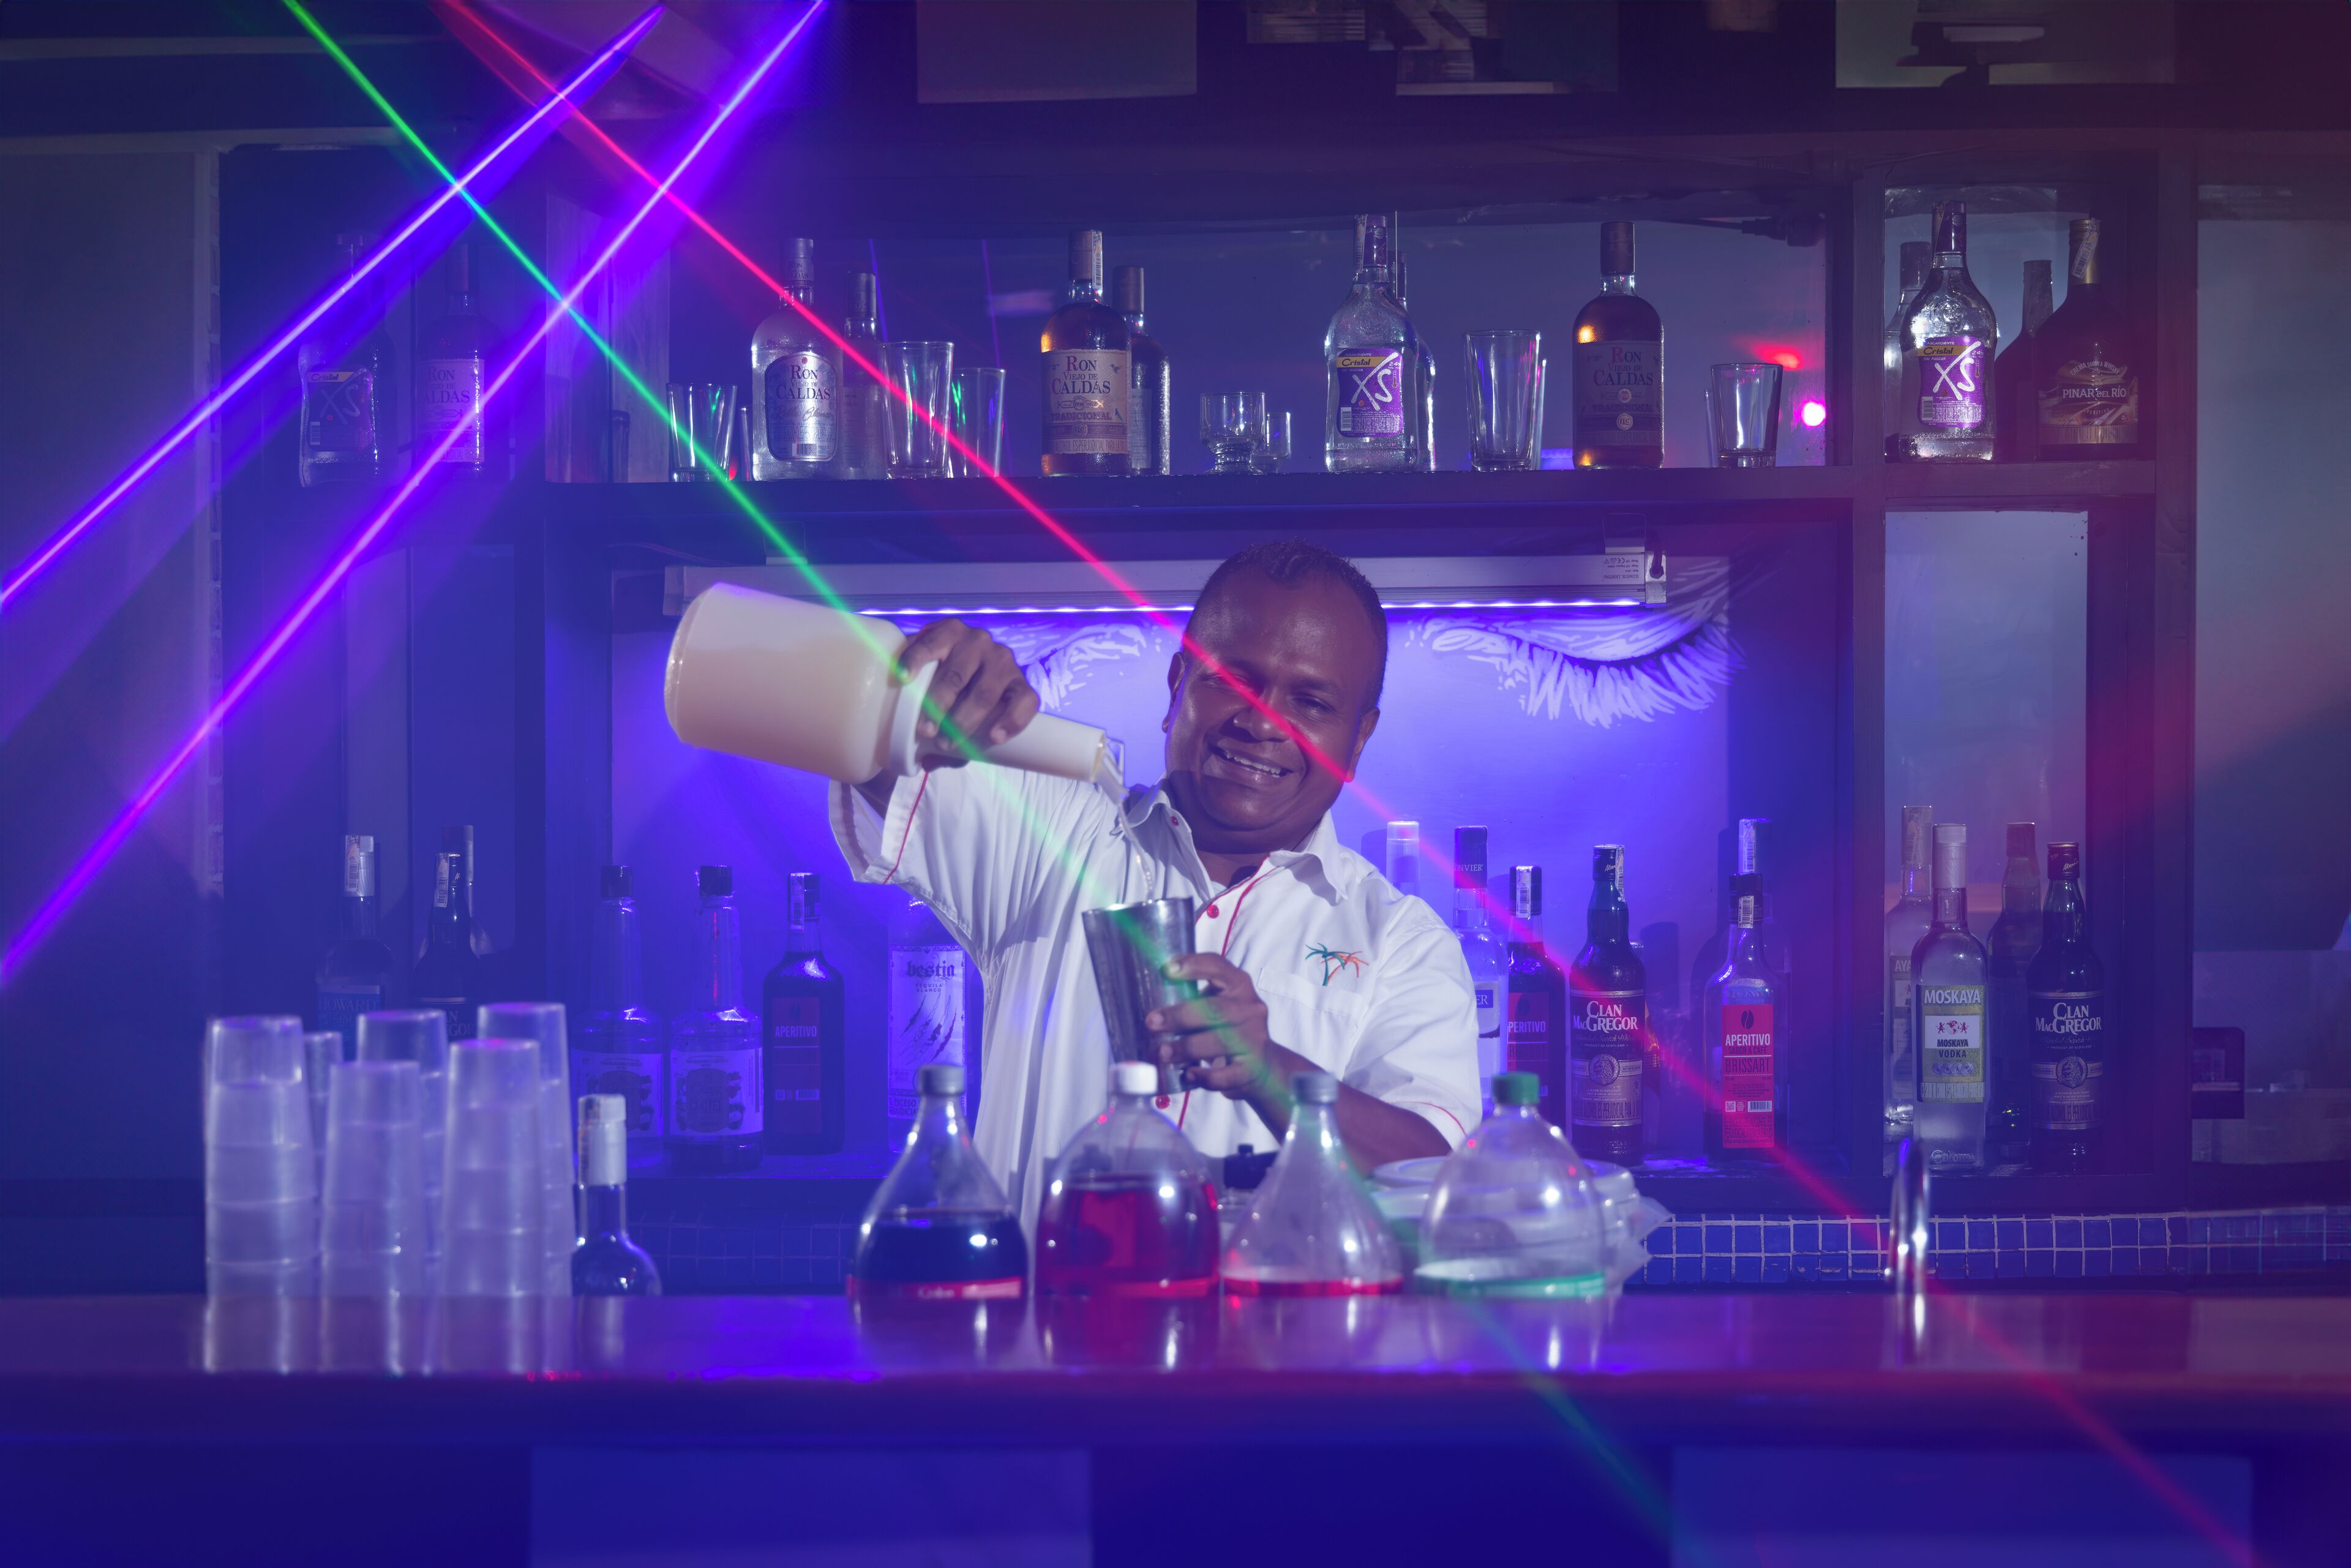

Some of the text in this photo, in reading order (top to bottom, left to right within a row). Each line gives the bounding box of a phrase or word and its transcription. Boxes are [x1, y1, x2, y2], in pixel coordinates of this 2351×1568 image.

[1611, 347, 1641, 363] RON
[1923, 347, 1954, 355] Cristal
[1065, 355, 1097, 371] RON
[1341, 358, 1371, 367] Cristal
[1608, 363, 1631, 372] VIEJO
[2070, 362, 2087, 376] CREMA
[789, 365, 819, 380] RON
[1063, 372, 1086, 380] VIEJO
[1593, 369, 1654, 386] CALDAS
[1932, 340, 1982, 401] XS
[1051, 378, 1111, 395] CALDAS
[1351, 352, 1399, 411] XS
[424, 389, 470, 403] ALDAS
[776, 384, 831, 400] CALDAS
[2062, 388, 2094, 399] PINAR
[2111, 384, 2127, 398] RÍO
[1051, 412, 1112, 422] TRADICIONAL
[906, 960, 956, 978] bestia
[1924, 989, 1981, 1005] MOSKAYA
[1586, 1001, 1622, 1018] CLAN
[2053, 1002, 2089, 1020] CLAN
[774, 1025, 817, 1038] APERITIVO
[1508, 1021, 1546, 1033] PERITIVO
[1725, 1033, 1771, 1046] APERITIVO
[1937, 1038, 1969, 1048] MOSKAYA
[1938, 1049, 1967, 1058] VODKA
[1725, 1057, 1770, 1073] BRISSART
